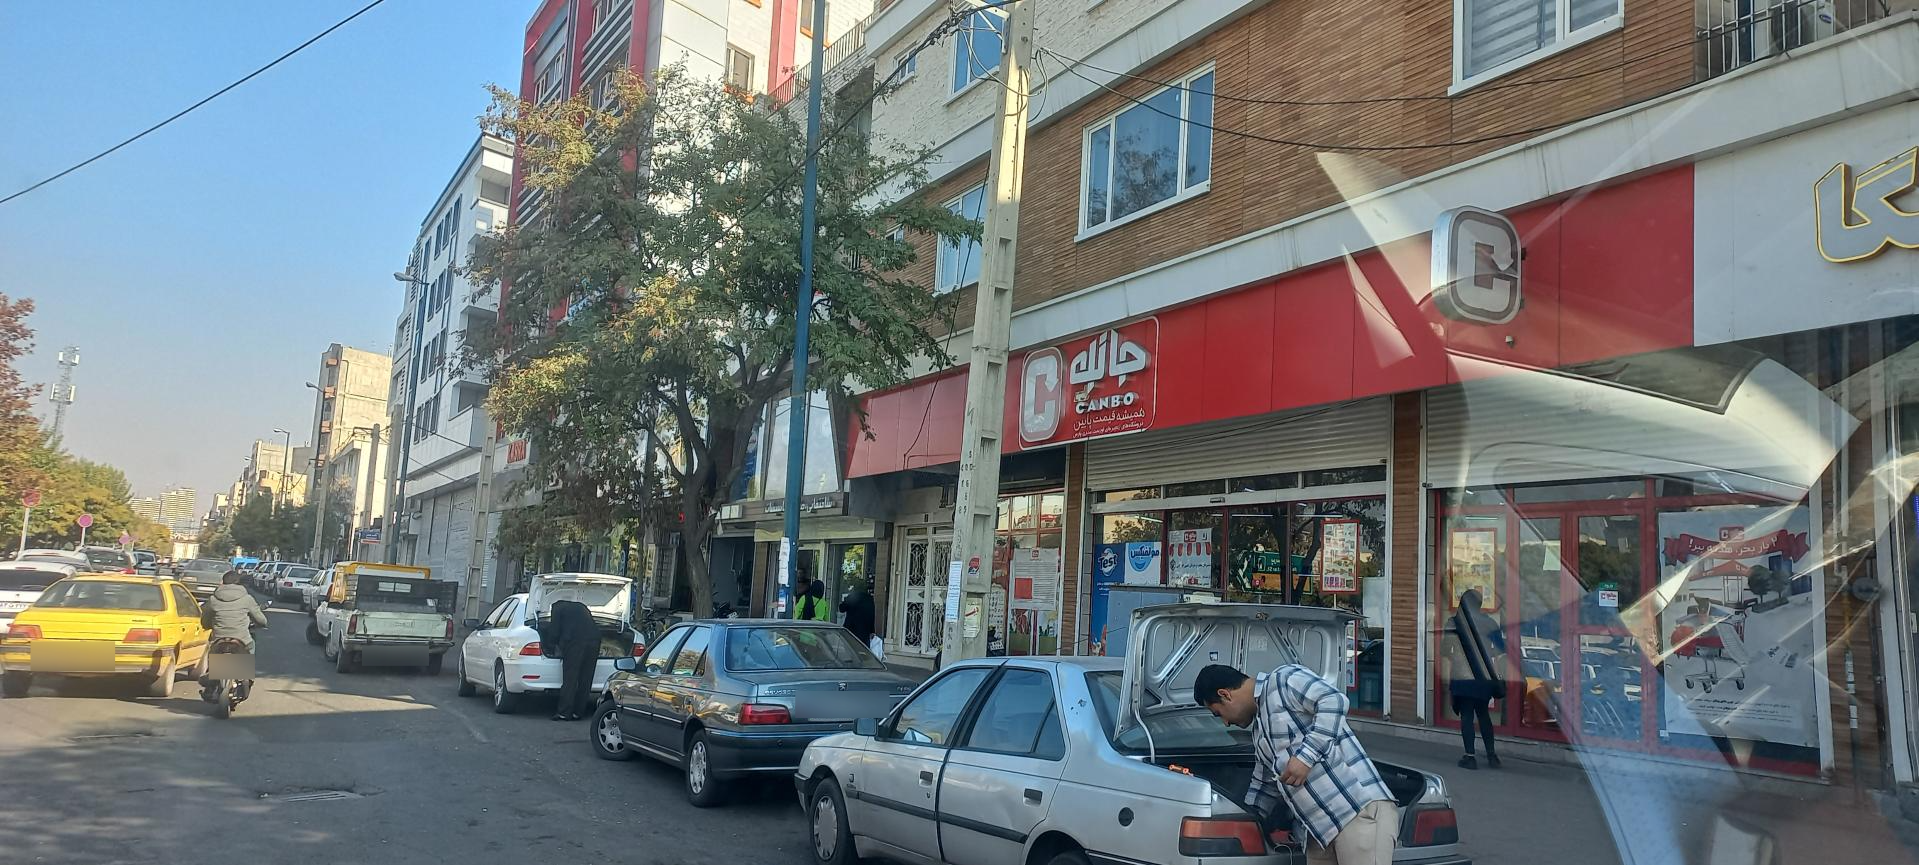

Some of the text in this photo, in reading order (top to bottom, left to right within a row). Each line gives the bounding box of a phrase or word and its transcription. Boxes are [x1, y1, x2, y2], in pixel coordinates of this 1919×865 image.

[1075, 391, 1136, 414] CANBO
[1073, 412, 1092, 431] پایین
[1092, 410, 1116, 424] قیمت
[1116, 407, 1146, 421] همیشه
[1758, 541, 1770, 554] بار
[1098, 553, 1118, 569] Test
